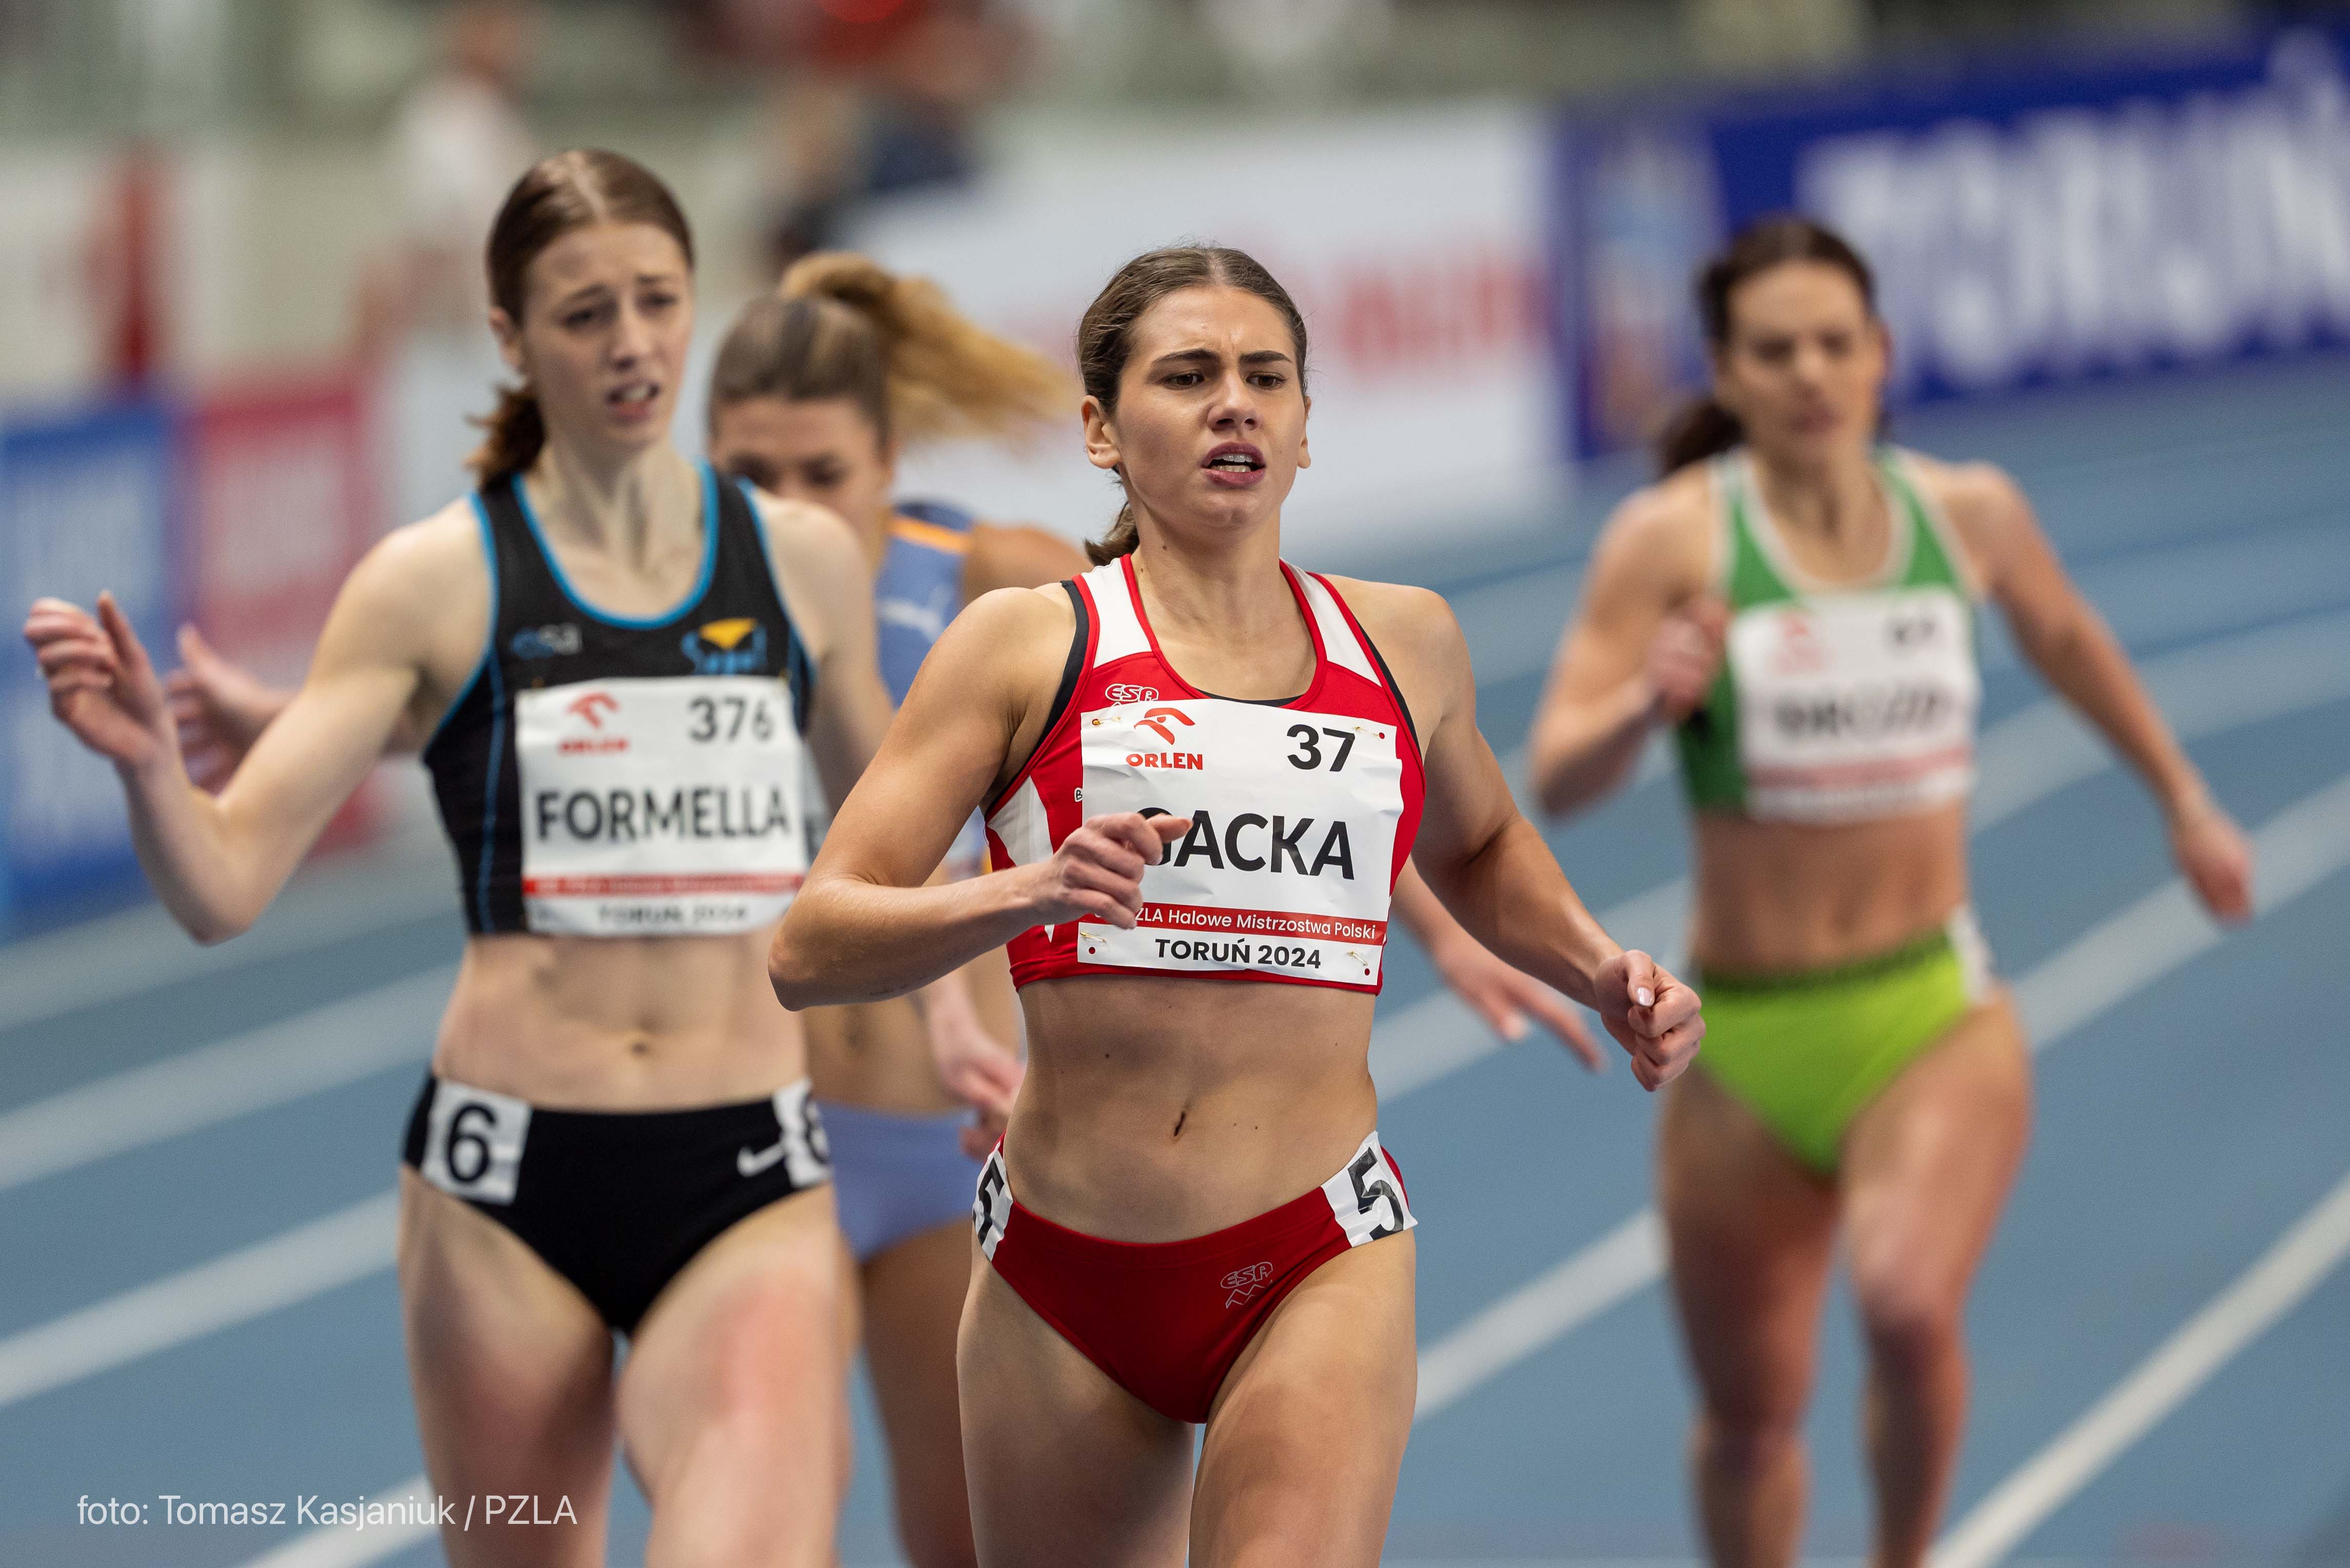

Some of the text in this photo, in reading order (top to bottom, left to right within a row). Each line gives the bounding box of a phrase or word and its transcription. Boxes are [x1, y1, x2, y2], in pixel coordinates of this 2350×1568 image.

[687, 695, 775, 744] 376
[1126, 752, 1203, 770] ORLEN
[1286, 724, 1356, 772] 37
[534, 786, 792, 844] FORMELLA
[1134, 907, 1376, 940] ZLA Halowe Mistrzostwa Polski
[1155, 938, 1321, 969] TORUŃ 2024
[446, 1101, 496, 1185] 6
[1347, 1146, 1404, 1241] 5
